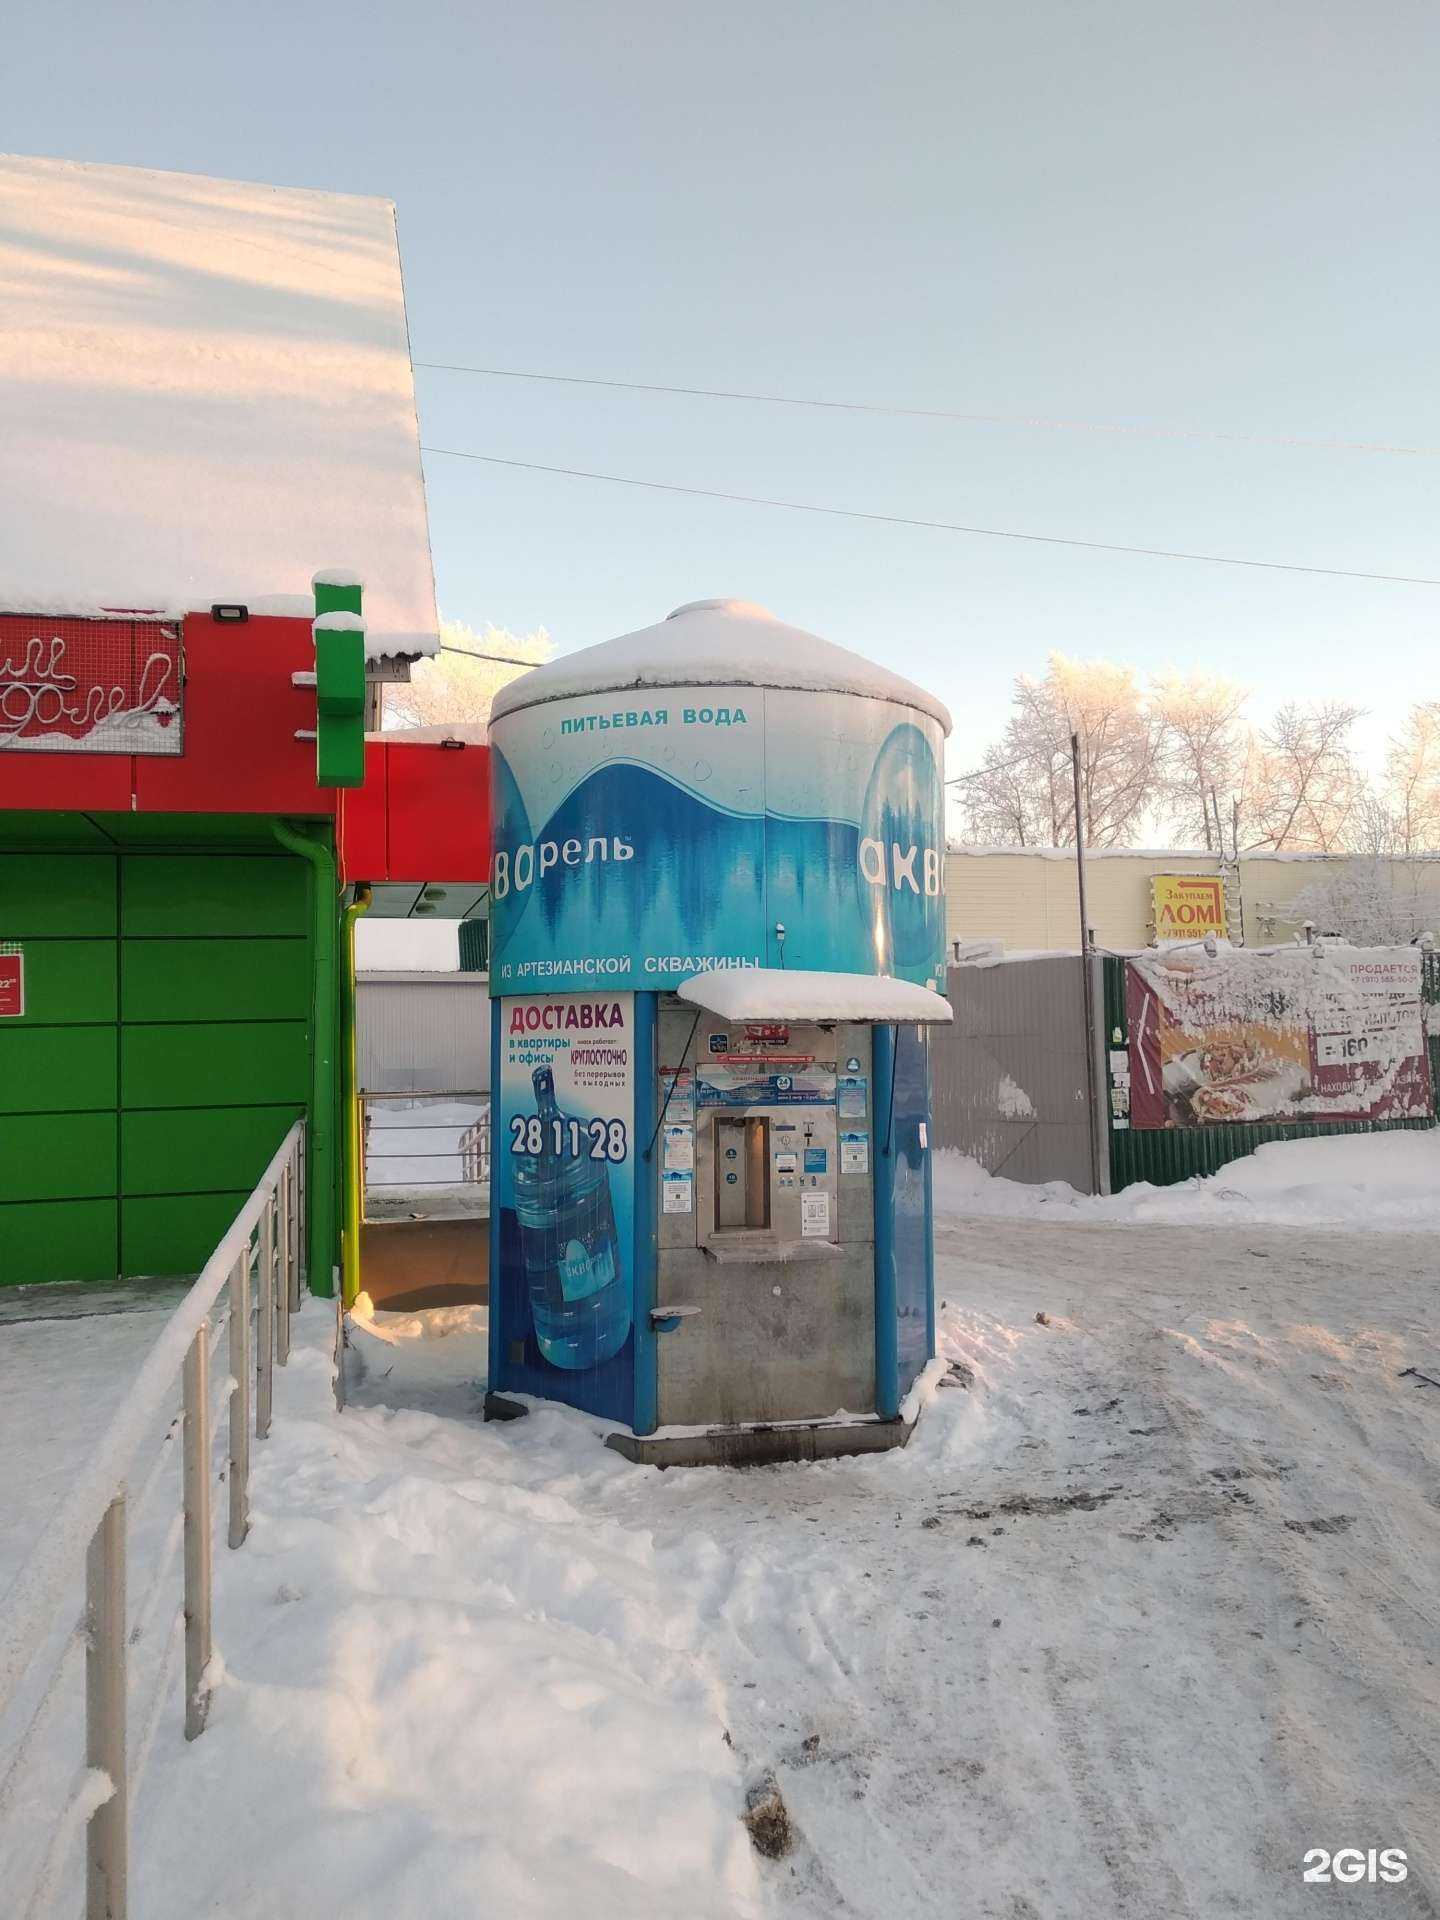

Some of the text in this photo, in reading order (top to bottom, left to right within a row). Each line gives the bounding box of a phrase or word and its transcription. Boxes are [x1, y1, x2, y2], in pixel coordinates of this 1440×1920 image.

[561, 708, 747, 734] ПИТЬЕВАЯ ВОДА
[1160, 904, 1215, 924] ЛОМ
[501, 954, 759, 978] ИЗ АРТЕЗИАНСКОЙ СКВАЖИНЫ
[1350, 964, 1417, 974] ПРОДАЕТСЯ
[509, 1003, 624, 1034] ДОСТАВКА
[509, 1038, 571, 1052] в квартиры
[509, 1053, 554, 1067] и офисы
[571, 1049, 628, 1066] КРУГЛОСУТОЧНО
[510, 1114, 543, 1157] 28
[551, 1119, 580, 1157] 11
[588, 1118, 628, 1164] 28
